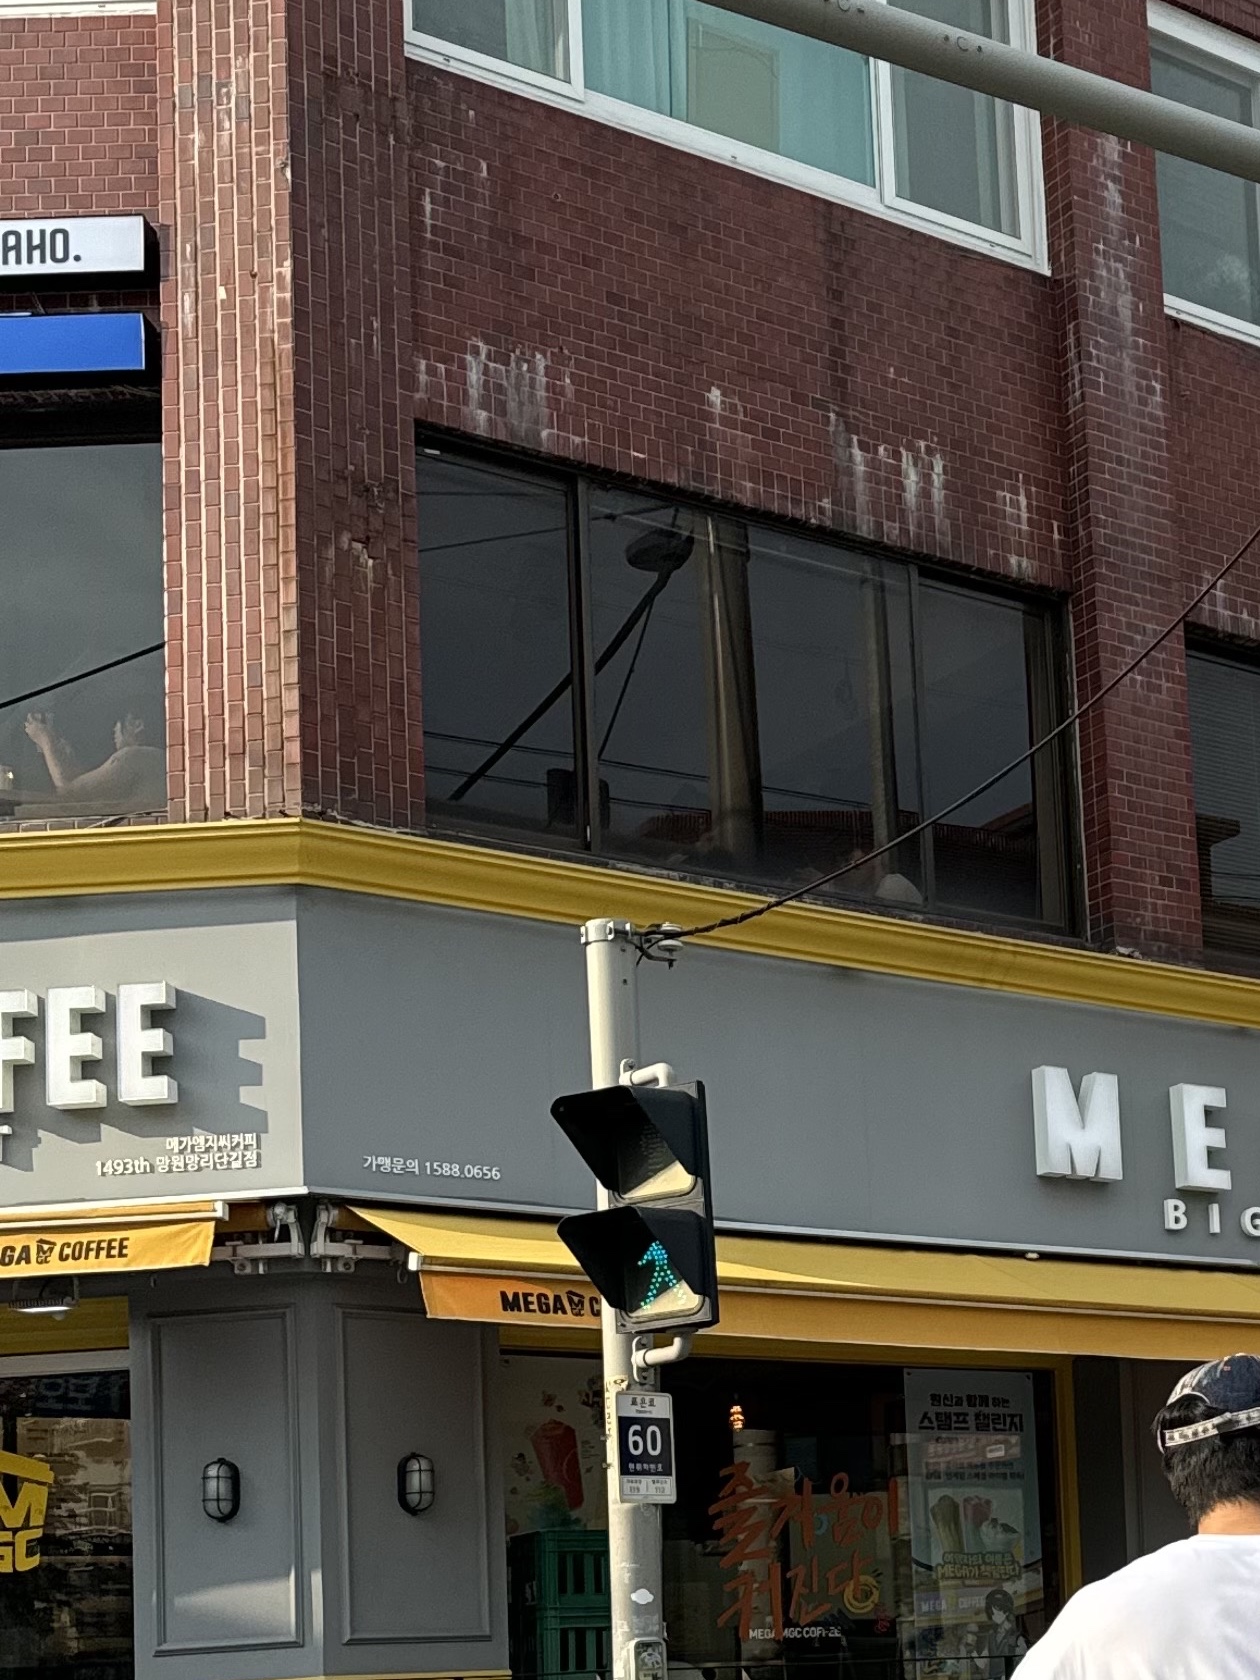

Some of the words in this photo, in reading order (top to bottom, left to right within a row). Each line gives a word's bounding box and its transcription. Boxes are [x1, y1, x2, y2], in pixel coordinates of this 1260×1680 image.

[2, 228, 82, 265] AHO.
[166, 1133, 257, 1153] 메가엠지씨커피
[96, 1156, 150, 1176] 1493th
[156, 1150, 258, 1173] 망원망리단길점
[363, 1155, 419, 1175] 가맹문의
[424, 1161, 501, 1181] 1588.0656
[58, 1237, 129, 1261] COFFEE
[500, 1290, 568, 1315] MEGA
[918, 1411, 970, 1431] 스탬프
[974, 1410, 1024, 1432] 챌린지
[628, 1424, 662, 1456] 60
